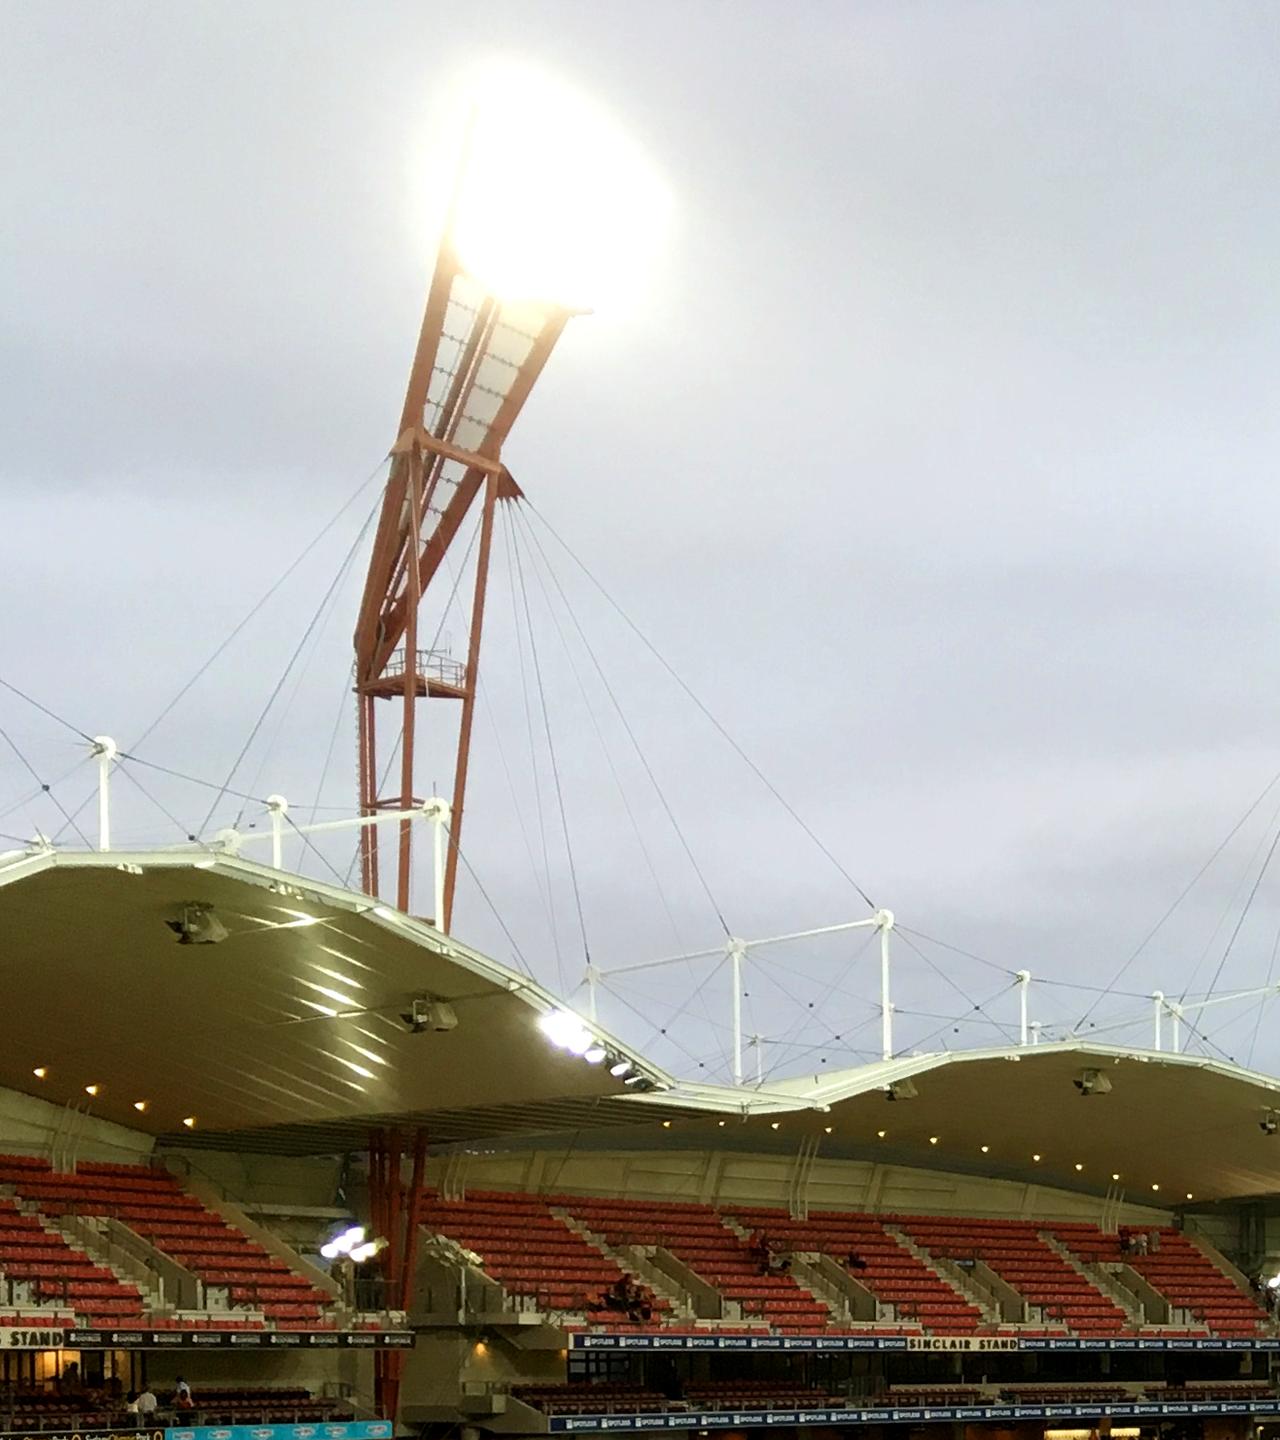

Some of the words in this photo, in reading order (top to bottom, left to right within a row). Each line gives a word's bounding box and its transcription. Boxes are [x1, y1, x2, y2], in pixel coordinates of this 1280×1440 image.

[10, 1331, 63, 1347] STAND
[909, 1339, 972, 1350] SINCLAIR
[979, 1339, 1018, 1350] STAND
